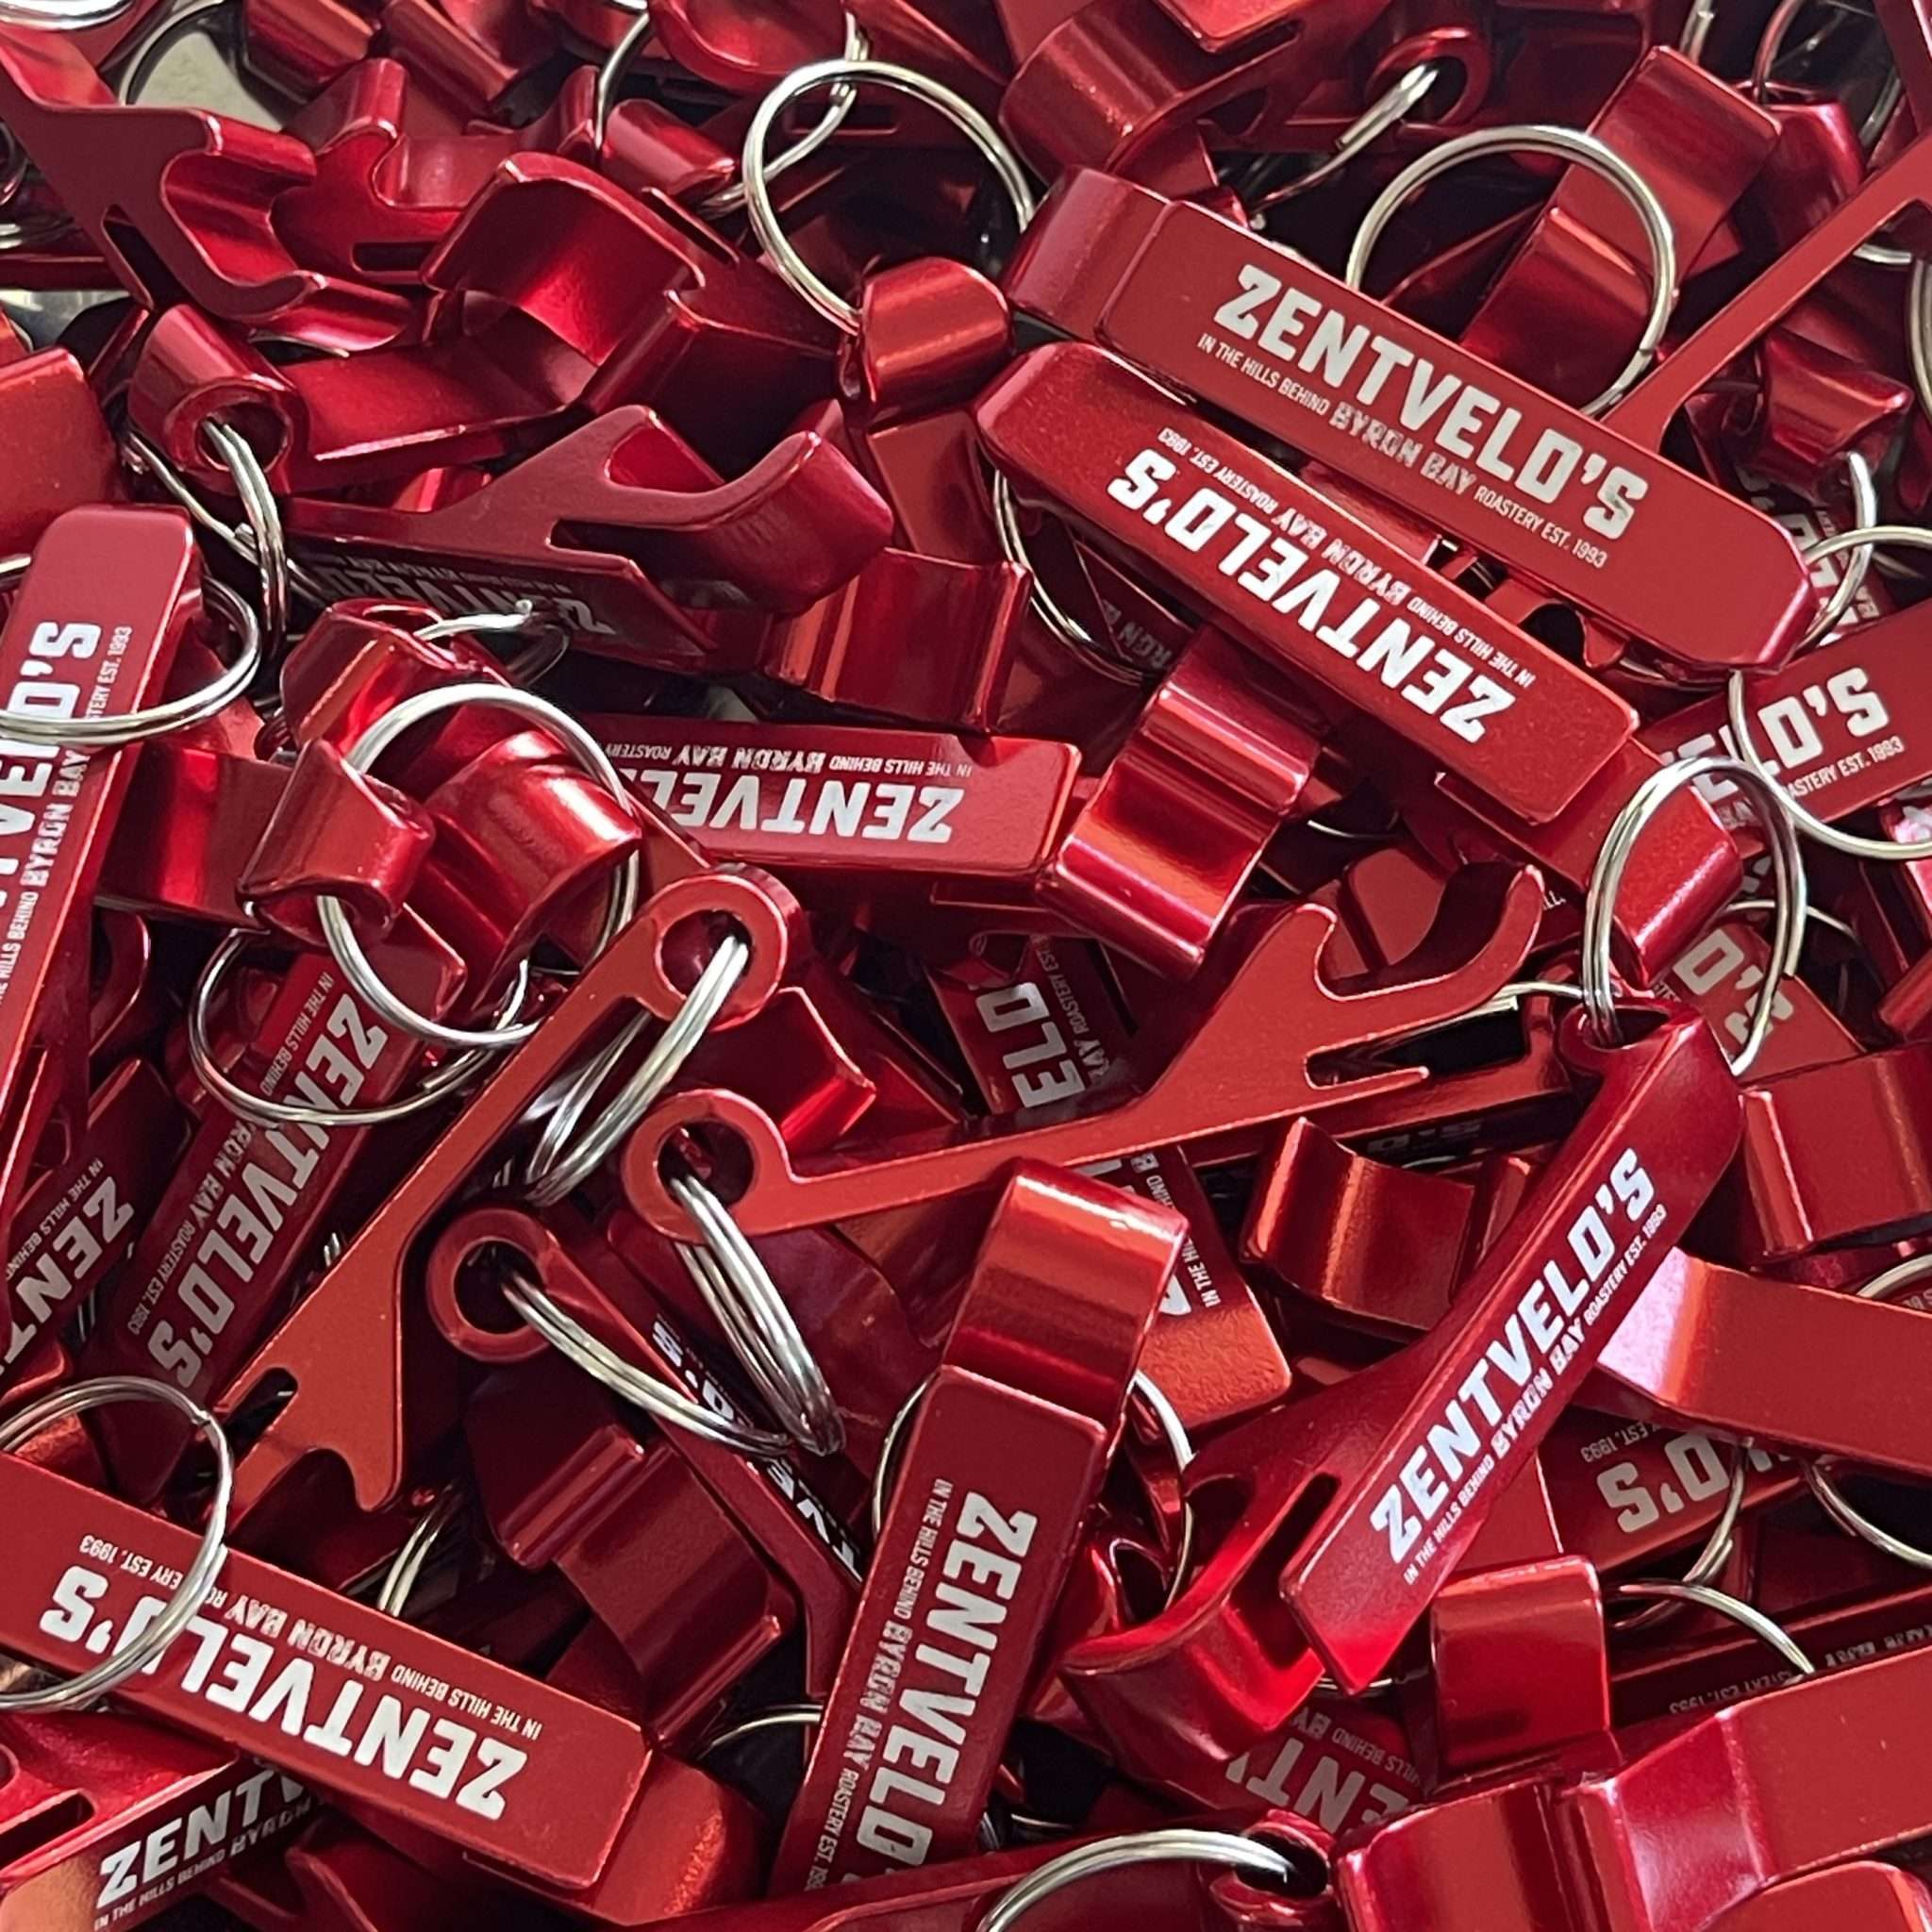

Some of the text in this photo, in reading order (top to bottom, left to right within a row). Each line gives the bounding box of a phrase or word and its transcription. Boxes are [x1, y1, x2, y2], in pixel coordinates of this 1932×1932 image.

[1213, 263, 1649, 541] ZENTVELD'S
[1158, 427, 1191, 456] 1993
[1197, 333, 1607, 569] IN THE HILLS BEHIND BYRON BAY ROASTERY EST. 1993
[1214, 466, 1278, 514] ROASTERY
[1271, 508, 1327, 550] BAY
[1321, 538, 1411, 606] BYRON
[1107, 449, 1516, 743] ZENTVELD'S
[1407, 596, 1457, 636] BEHIND
[108, 626, 133, 656] 1993
[1454, 628, 1493, 660] HILLS
[1488, 651, 1519, 678] THE
[1514, 669, 1536, 689] IN
[52, 750, 91, 797] BAY
[672, 744, 728, 767] BAY
[731, 746, 826, 774] BYRON
[828, 755, 883, 773] BEHIND
[884, 758, 924, 776] HILLS
[924, 761, 953, 777] THE
[956, 764, 973, 778] IN
[1839, 751, 1873, 778] EST.
[1867, 735, 1906, 763] 1993
[619, 768, 965, 843] ZENTVEL
[20, 803, 74, 887] BYRON
[7, 891, 39, 940] BEHIND
[318, 972, 335, 992] IN
[305, 989, 326, 1017] THE
[285, 1012, 312, 1051] HILLS
[259, 1047, 293, 1096] BEHIND
[88, 1158, 104, 1178] IN
[213, 1123, 257, 1178] RON
[68, 1174, 92, 1203] THE
[147, 993, 389, 1389] ZENTVELD'S
[190, 1174, 224, 1227] BAY
[40, 1198, 71, 1236] HILLS
[158, 1220, 196, 1283] ROASTERY
[1187, 1261, 1212, 1291] THE
[1201, 1289, 1222, 1308] IN
[1370, 1147, 1655, 1564] ZENTVELD'S
[1403, 1560, 1419, 1585] IN
[1415, 1538, 1436, 1568] THE
[1433, 1504, 1462, 1543] HILLS
[1457, 1454, 1494, 1507] BEHIND
[1490, 1367, 1554, 1459] BYRON
[1549, 1317, 1585, 1375] BAY
[1583, 1258, 1628, 1326] ROASTERY
[1580, 1438, 1619, 1463] 1993
[932, 1478, 953, 1499] IN
[923, 1499, 947, 1527] THE
[79, 1534, 119, 1564] 1993
[120, 1548, 154, 1577] EST.
[910, 1525, 939, 1567] HILLS
[893, 1565, 925, 1620] BEHIND
[225, 1595, 288, 1639] BAY
[287, 1618, 391, 1682] BYRON
[859, 1620, 913, 1713] BYRON
[39, 1565, 528, 1821] ZENTVELD'S
[391, 1663, 450, 1702] BEHIND
[842, 1491, 1038, 1883] ZENTVELD
[448, 1688, 492, 1720] HILLS
[491, 1705, 522, 1733] THE
[522, 1717, 543, 1741] IN
[843, 1713, 882, 1771] BAY
[824, 1768, 859, 1837] ROASTERY
[93, 1913, 109, 1931] IN
[112, 1897, 136, 1922] THE
[139, 1875, 175, 1907] HILLS
[177, 1848, 226, 1885] BEHIND
